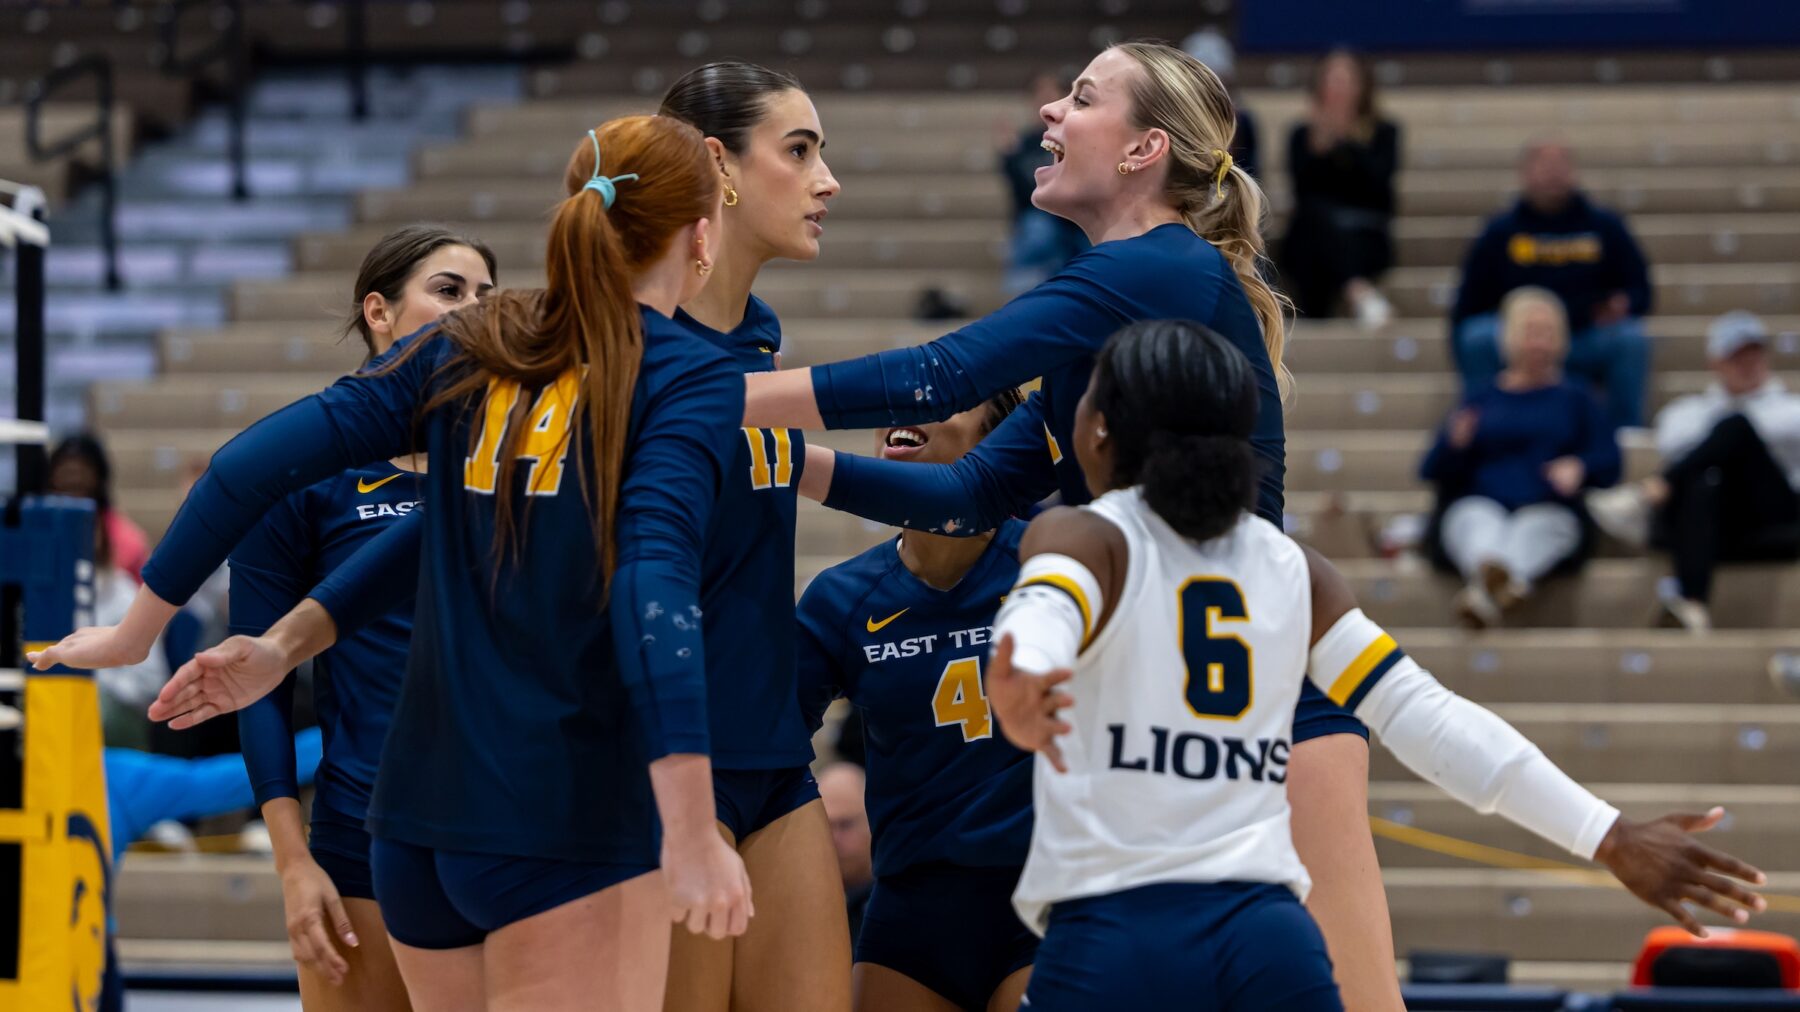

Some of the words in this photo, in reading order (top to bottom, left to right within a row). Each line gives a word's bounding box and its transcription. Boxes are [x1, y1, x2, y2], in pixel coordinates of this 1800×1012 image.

[464, 363, 590, 496] 14
[740, 427, 793, 490] 11
[863, 634, 937, 663] EAST
[1177, 574, 1253, 721] 6
[931, 655, 992, 743] 4
[1107, 723, 1290, 784] LIONS
